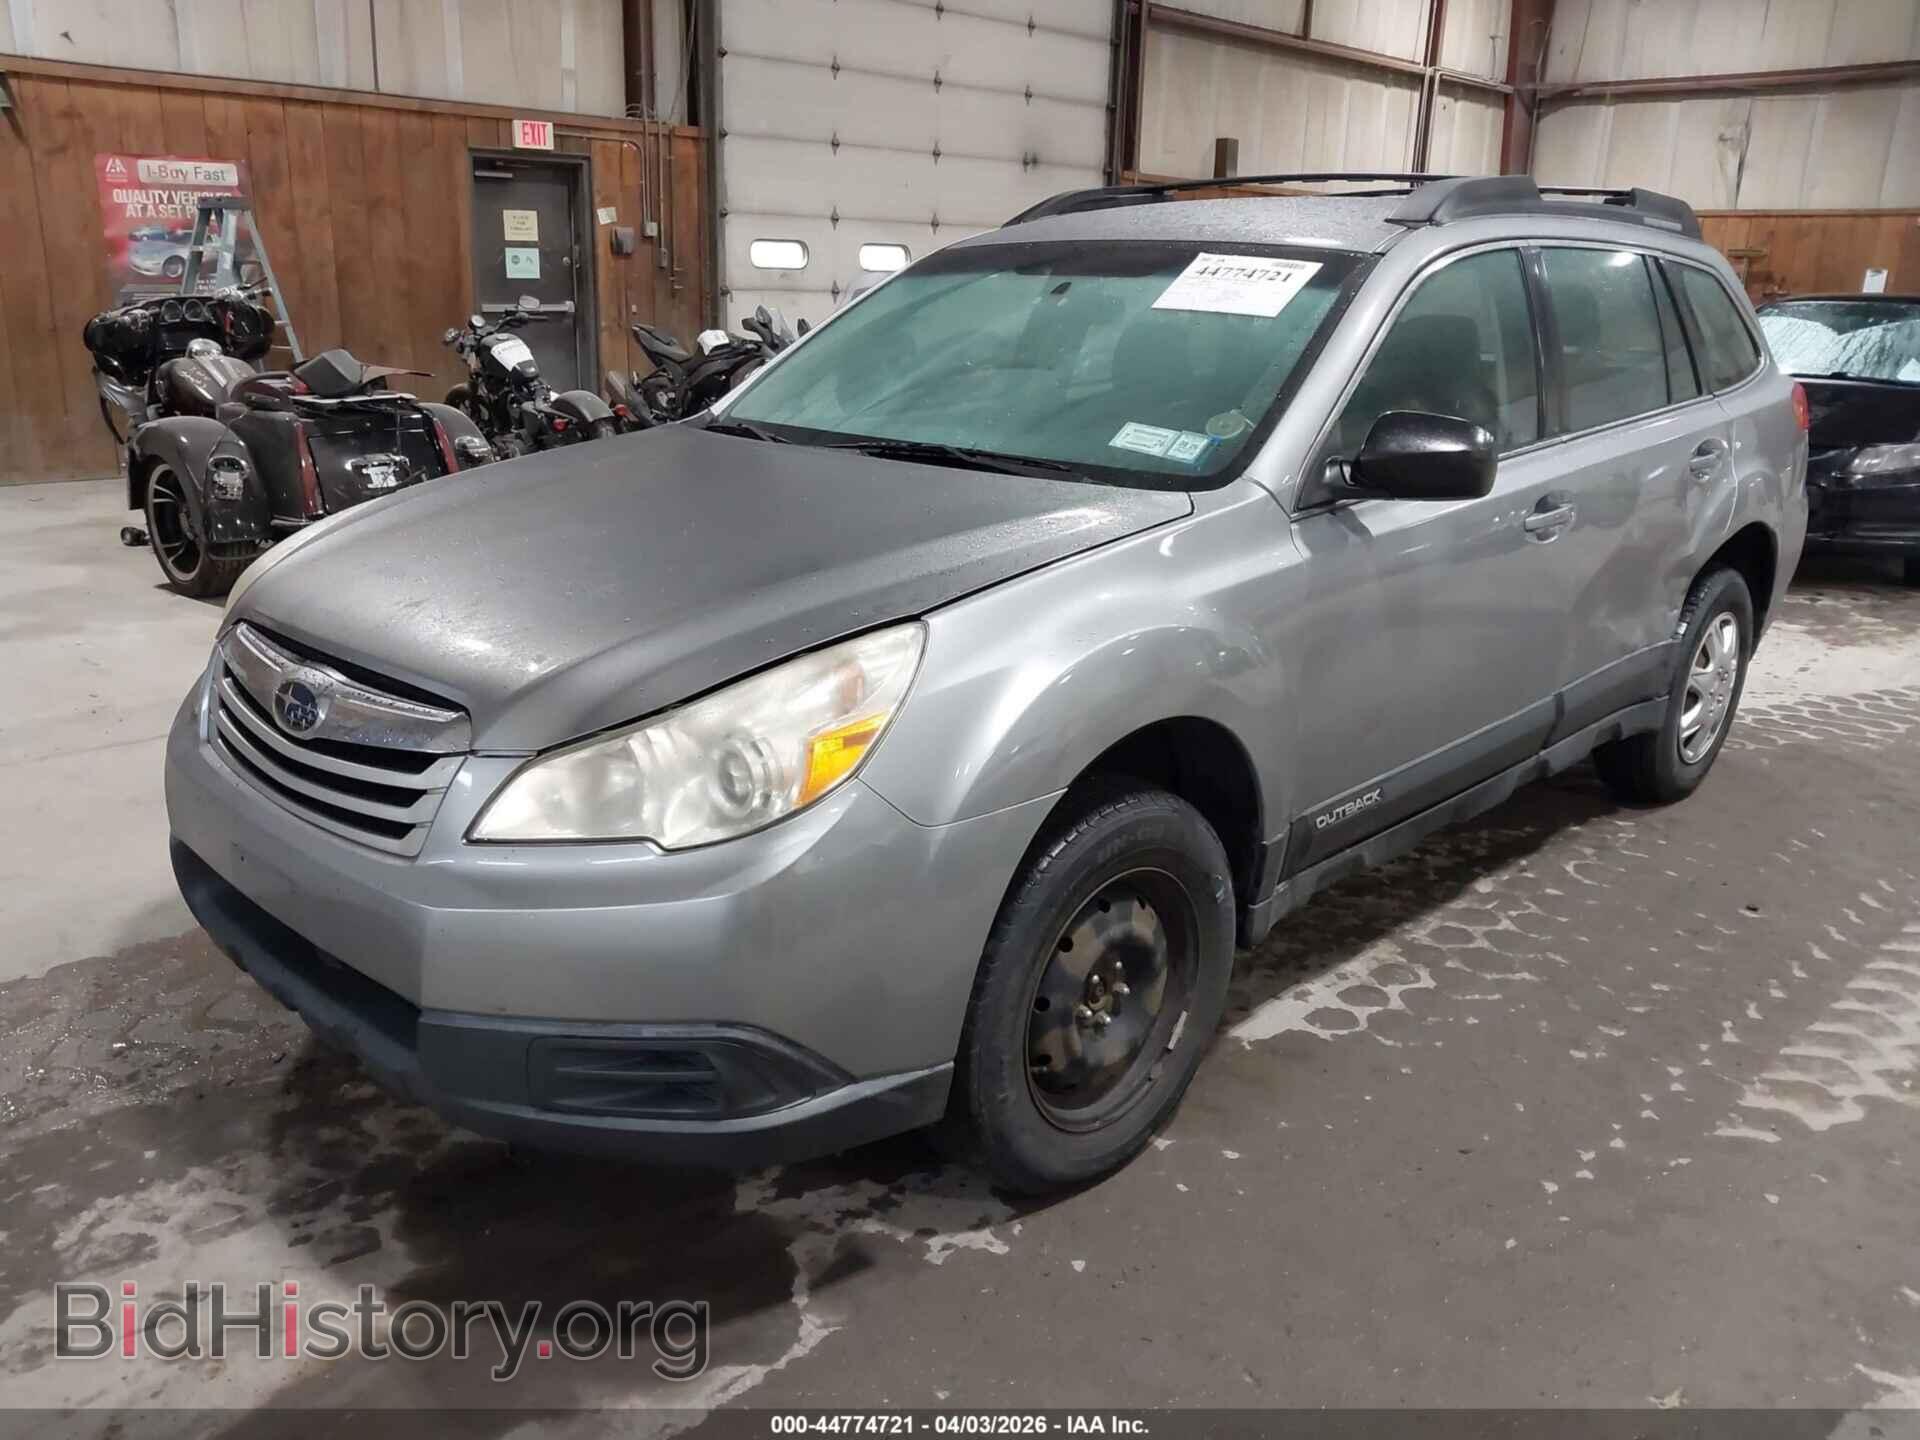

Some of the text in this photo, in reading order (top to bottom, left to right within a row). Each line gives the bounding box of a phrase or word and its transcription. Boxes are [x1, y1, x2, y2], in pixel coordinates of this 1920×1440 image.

[522, 122, 547, 146] EXIT
[146, 165, 188, 182] I-Buy
[194, 167, 226, 182] Fast
[112, 189, 169, 205] QUALITY
[126, 204, 144, 218] AT
[147, 204, 158, 218] A
[159, 204, 183, 219] SET
[1196, 266, 1293, 283] 44774721
[1315, 788, 1382, 829] OUTBACK
